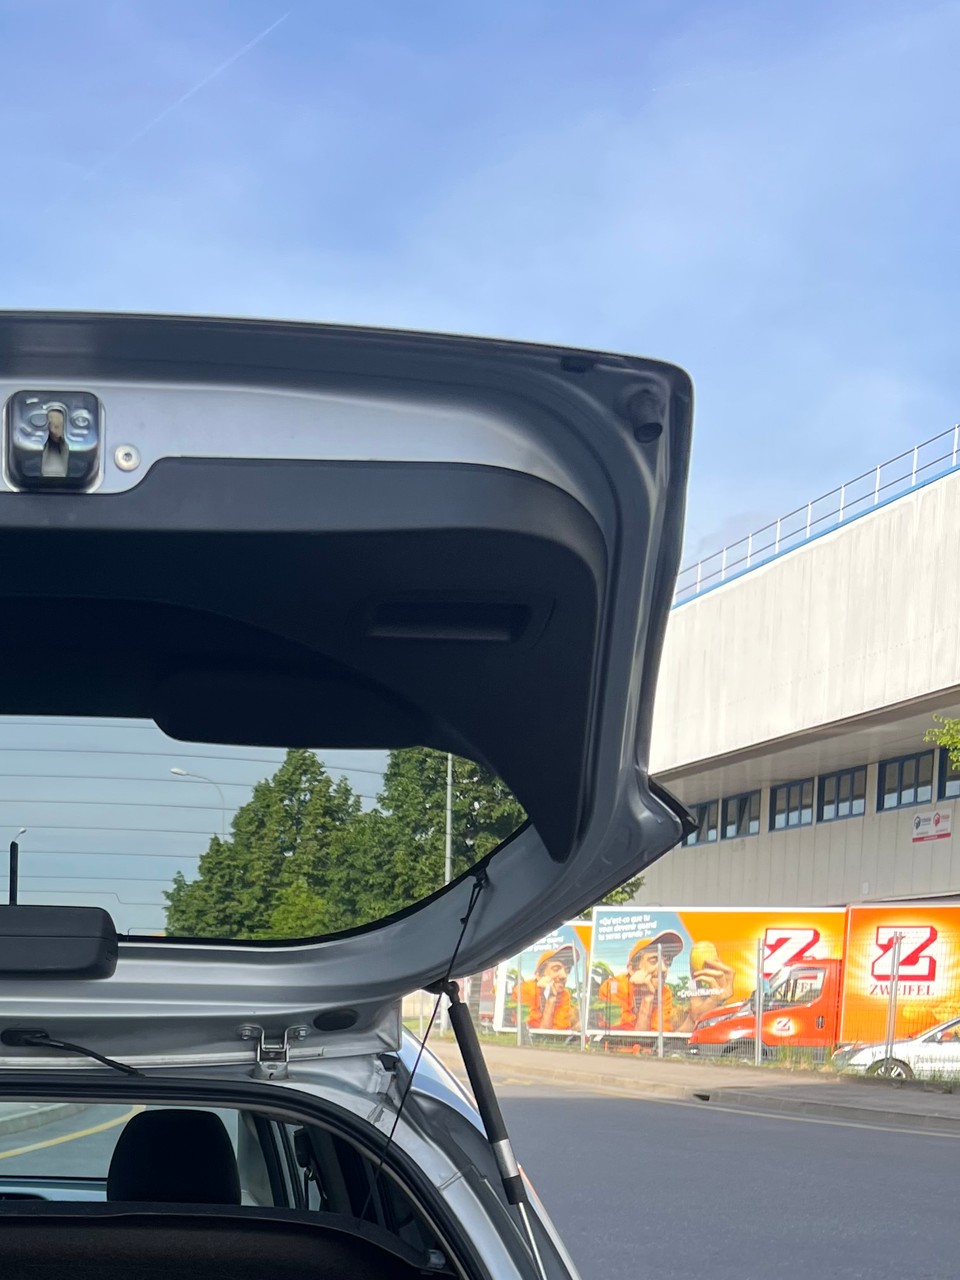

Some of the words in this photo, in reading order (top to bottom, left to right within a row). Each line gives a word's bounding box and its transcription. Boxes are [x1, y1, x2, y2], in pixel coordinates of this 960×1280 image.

[631, 915, 643, 924] que
[643, 914, 651, 922] tu
[637, 921, 657, 930] quand
[871, 925, 938, 982] Z
